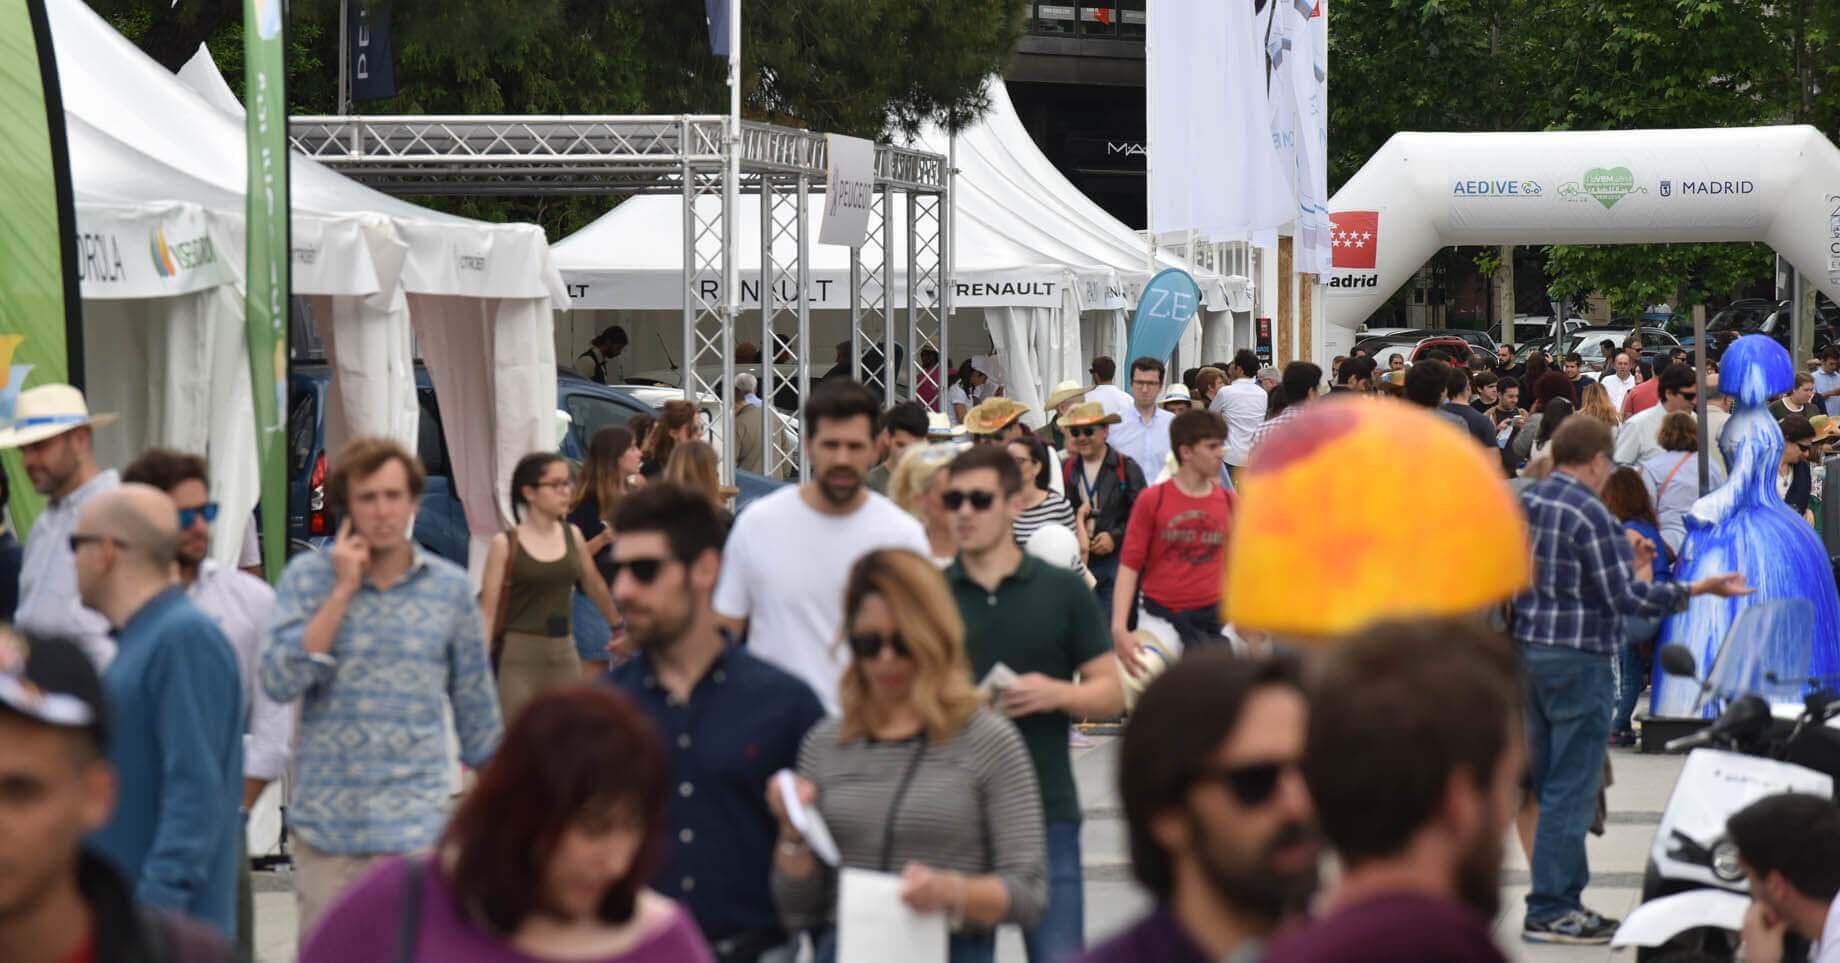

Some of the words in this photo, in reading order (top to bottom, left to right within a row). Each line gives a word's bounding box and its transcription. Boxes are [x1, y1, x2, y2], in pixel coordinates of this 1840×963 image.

[1107, 142, 1147, 157] MA
[1453, 180, 1519, 194] AEDIVE
[1682, 181, 1755, 194] MADRID
[838, 180, 872, 209] PEUGEOT
[1326, 275, 1378, 288] adrid
[956, 282, 1056, 296] RENAULT
